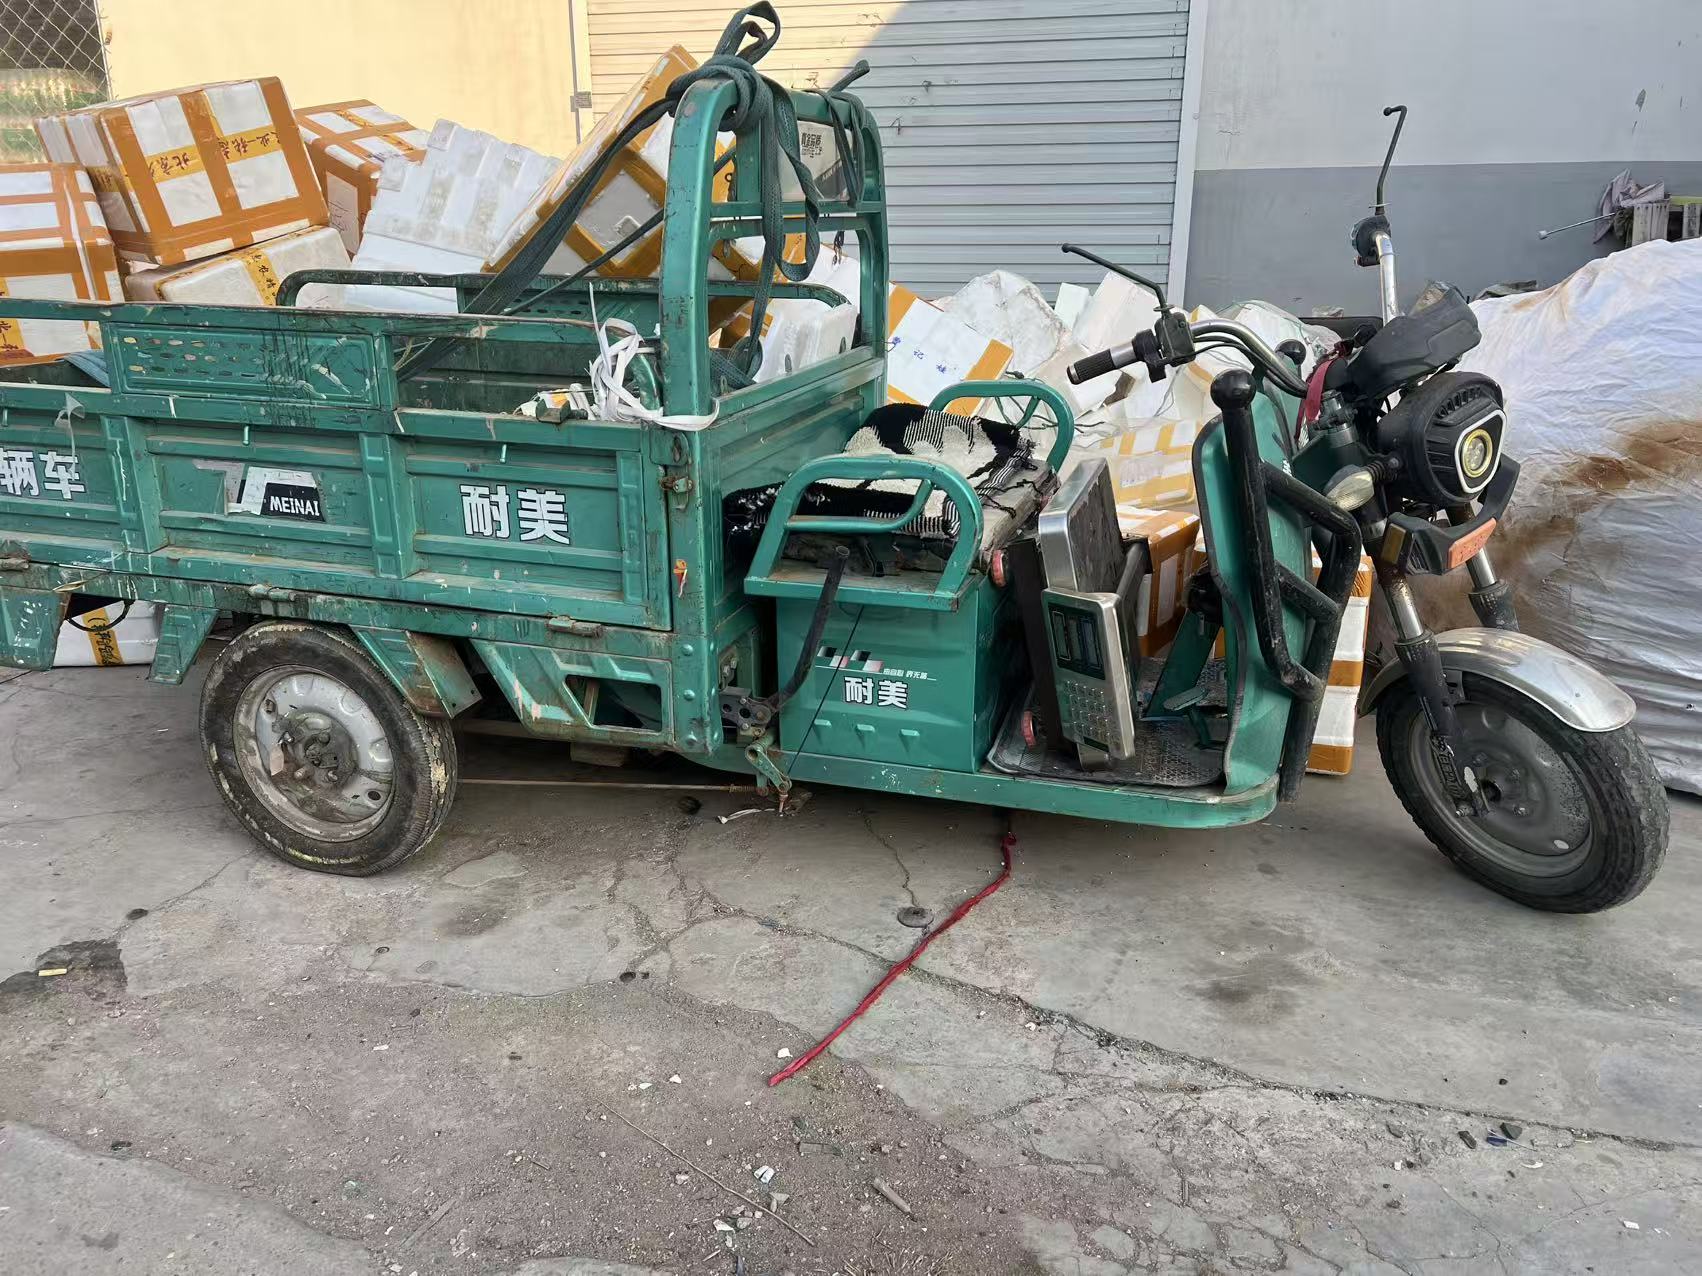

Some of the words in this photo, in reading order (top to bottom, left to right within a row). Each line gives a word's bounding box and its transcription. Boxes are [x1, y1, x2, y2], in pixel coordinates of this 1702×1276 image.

[269, 495, 320, 517] MEINAI
[459, 483, 570, 545] 耐美
[844, 676, 908, 709] 耐美
